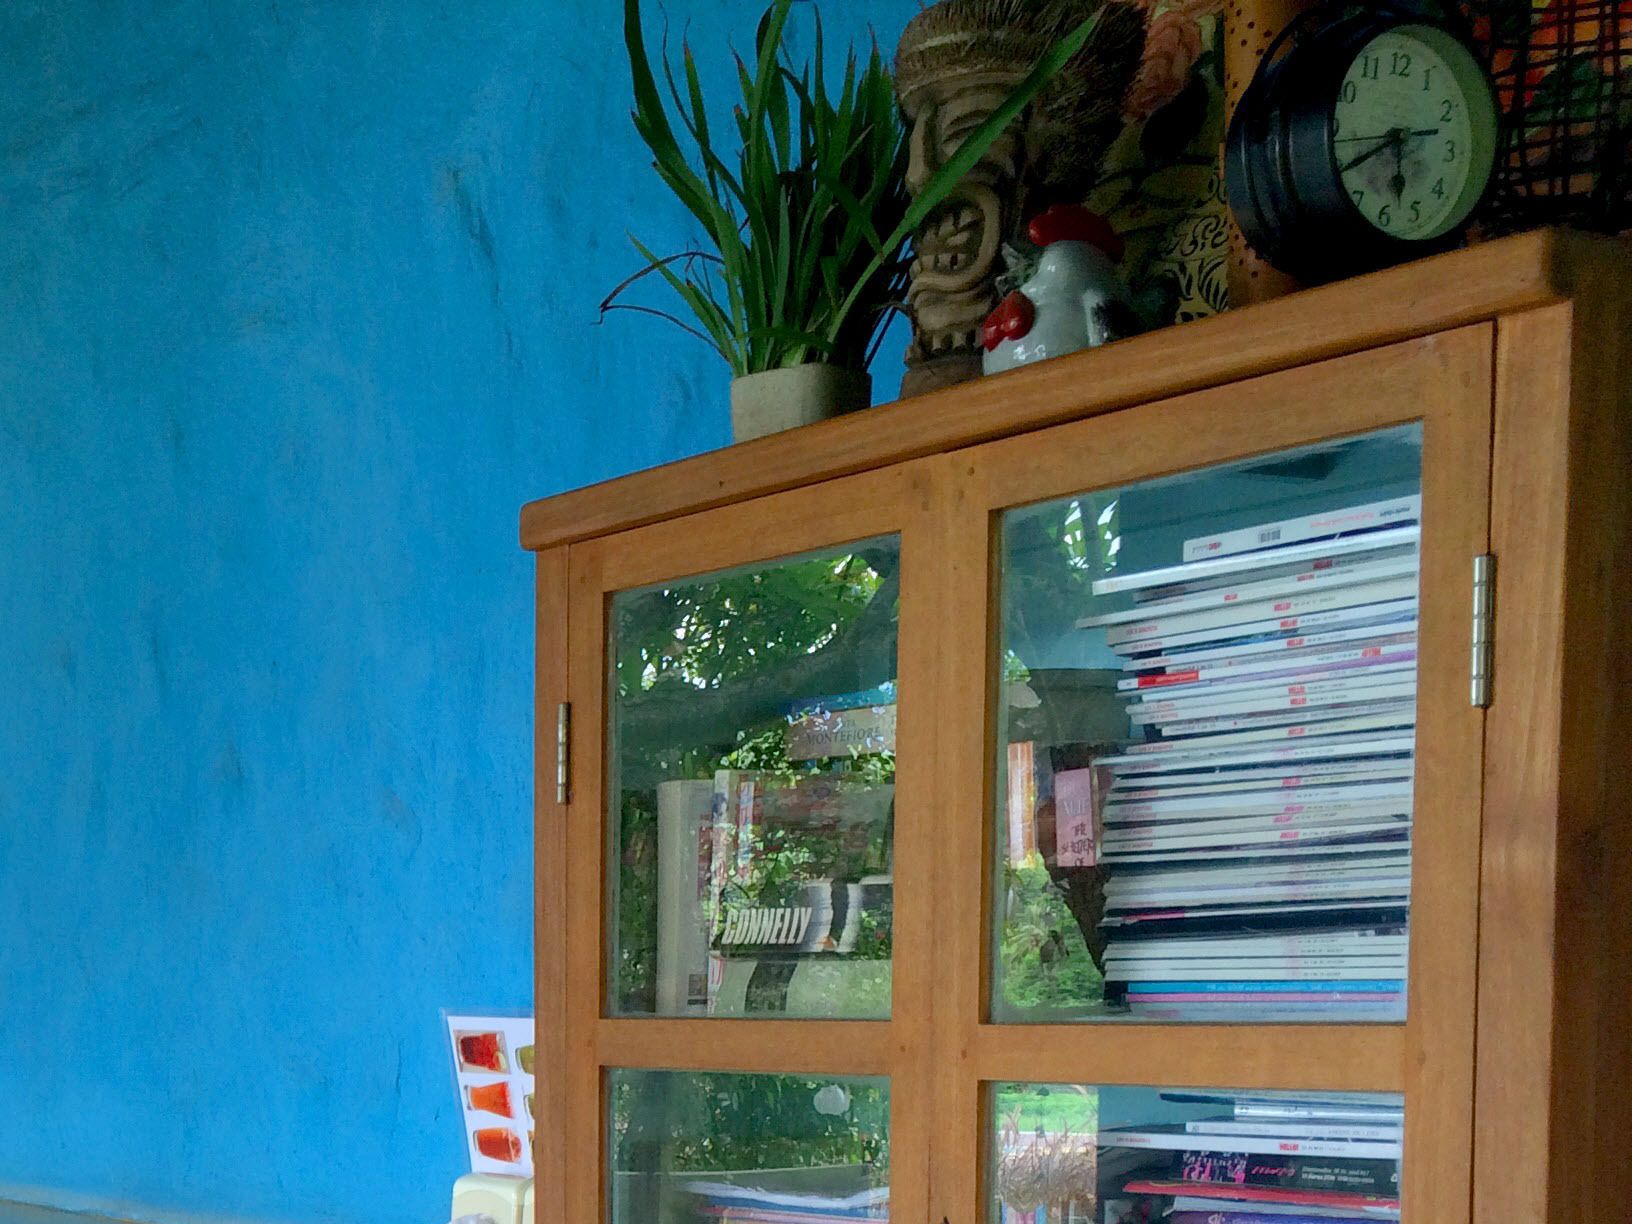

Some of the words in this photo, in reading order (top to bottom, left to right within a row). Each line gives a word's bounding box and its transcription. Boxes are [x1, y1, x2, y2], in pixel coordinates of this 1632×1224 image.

[1361, 56, 1379, 80] 11
[1389, 52, 1412, 77] 12
[1423, 69, 1431, 91] 1
[1440, 100, 1452, 122] 2
[1443, 140, 1455, 163] 3
[1431, 177, 1444, 200] 4
[1378, 205, 1390, 227] 6
[1408, 201, 1421, 223] 5
[721, 907, 813, 945] CONNELLY
